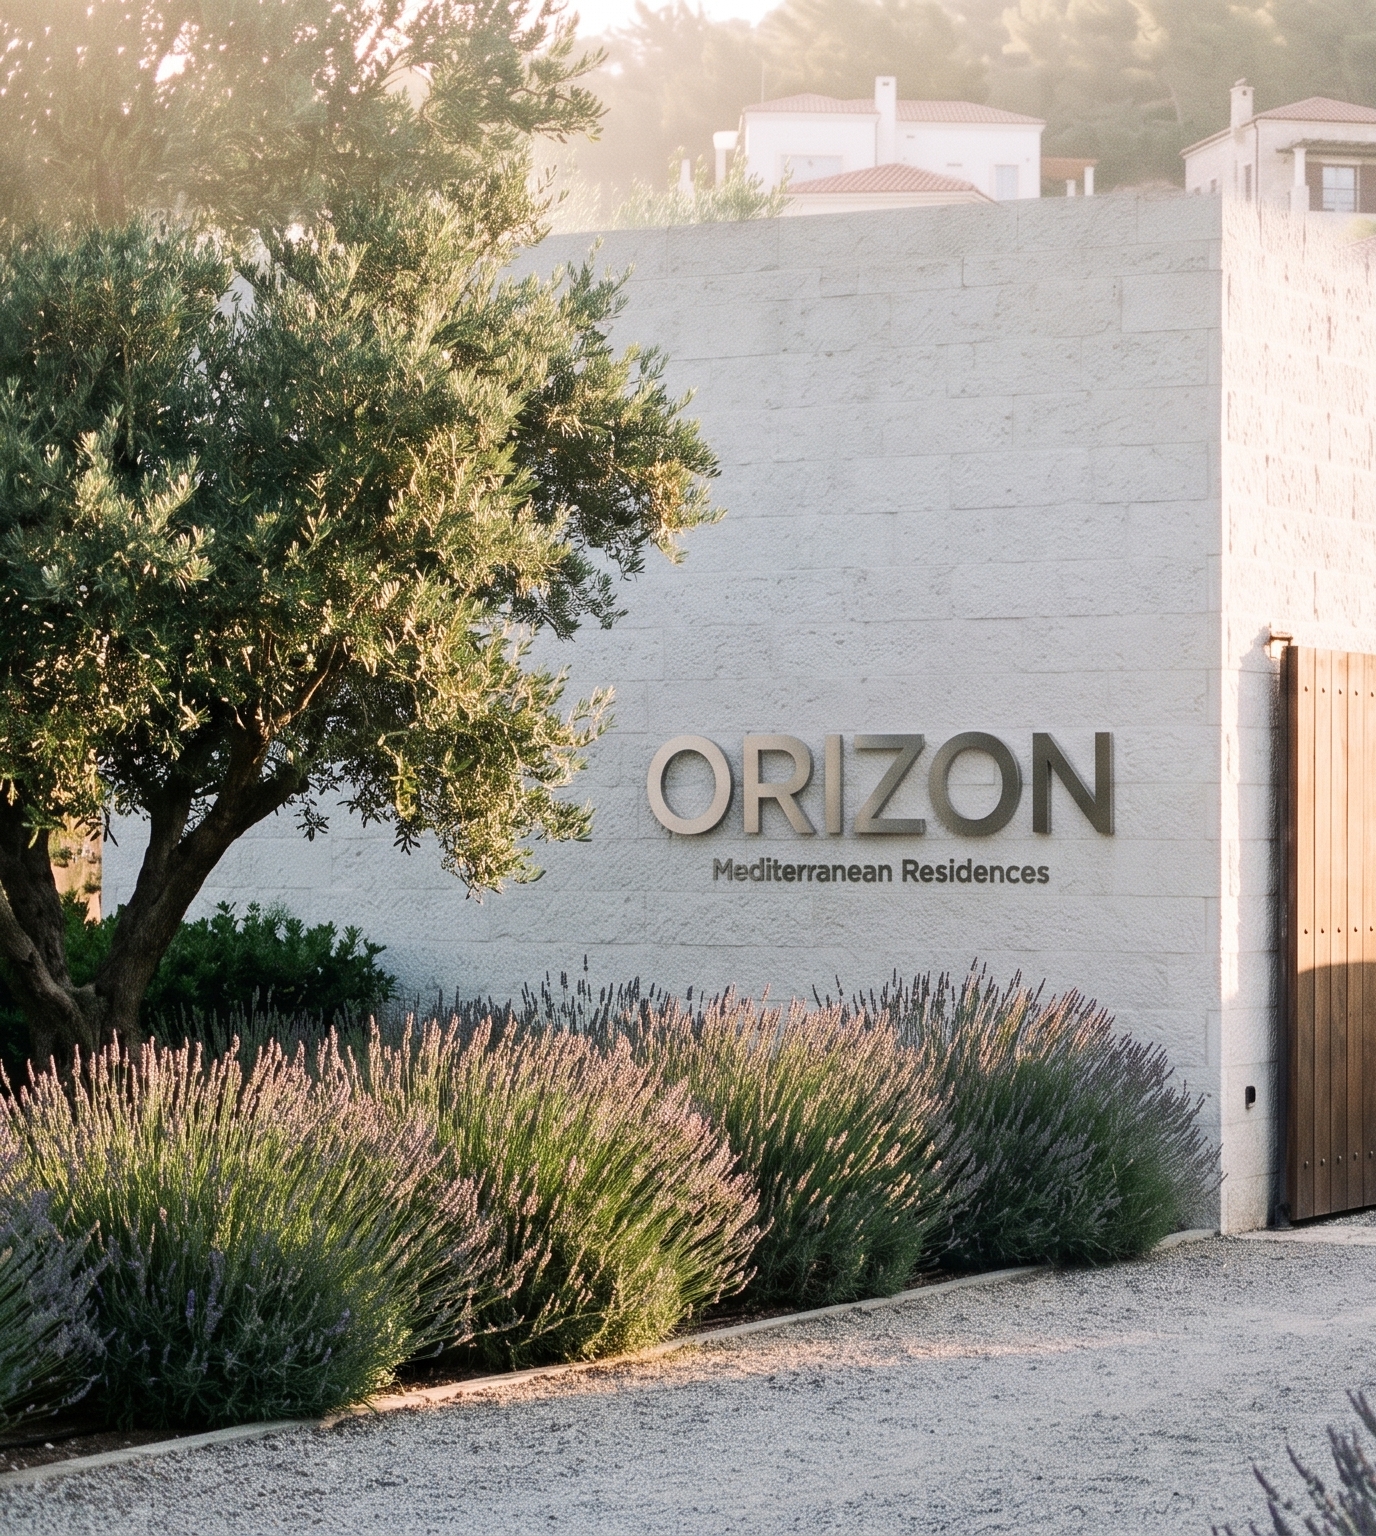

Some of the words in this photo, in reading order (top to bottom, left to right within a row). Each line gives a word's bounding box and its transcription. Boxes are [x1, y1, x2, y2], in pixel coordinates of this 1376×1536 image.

[647, 731, 1114, 836] ORIZON
[712, 857, 893, 882] Mediterranean
[902, 858, 1050, 884] Residences
